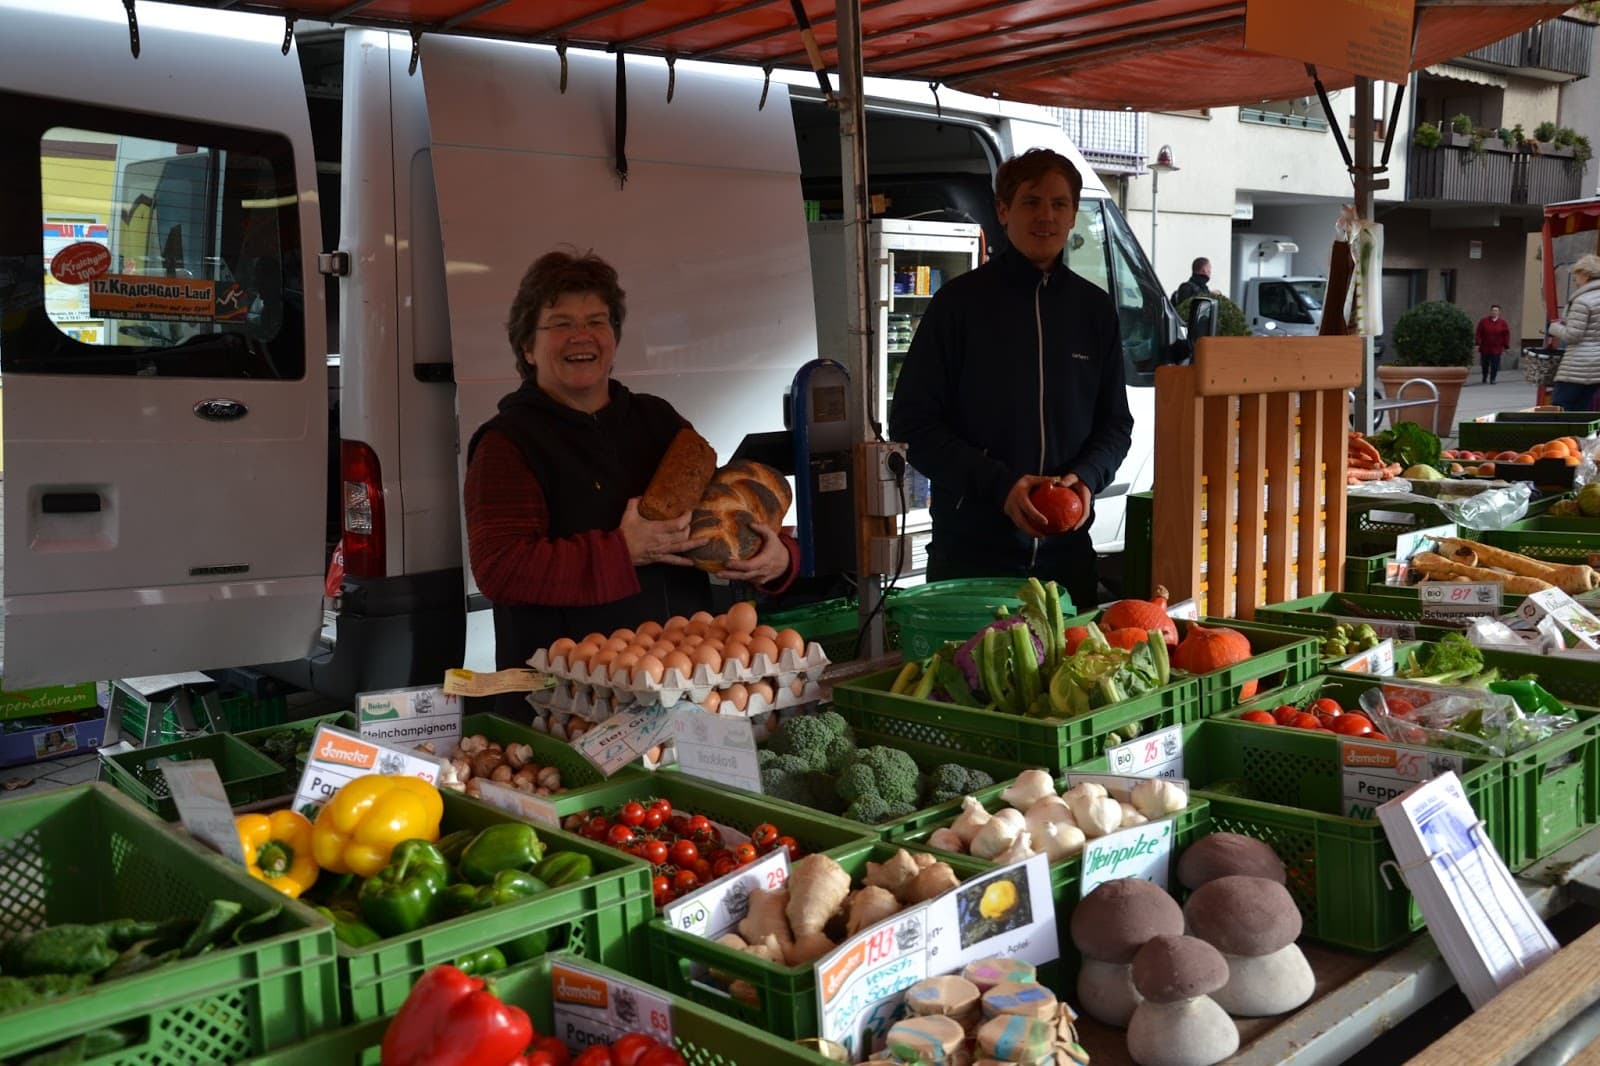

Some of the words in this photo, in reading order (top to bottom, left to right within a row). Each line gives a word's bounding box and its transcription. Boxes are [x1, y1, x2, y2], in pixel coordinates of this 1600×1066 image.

[320, 740, 369, 764] demeter
[1346, 749, 1390, 763] demeter
[766, 867, 785, 889] 29
[682, 908, 705, 929] BIO
[558, 977, 603, 1000] demeter
[650, 1010, 668, 1032] 63
